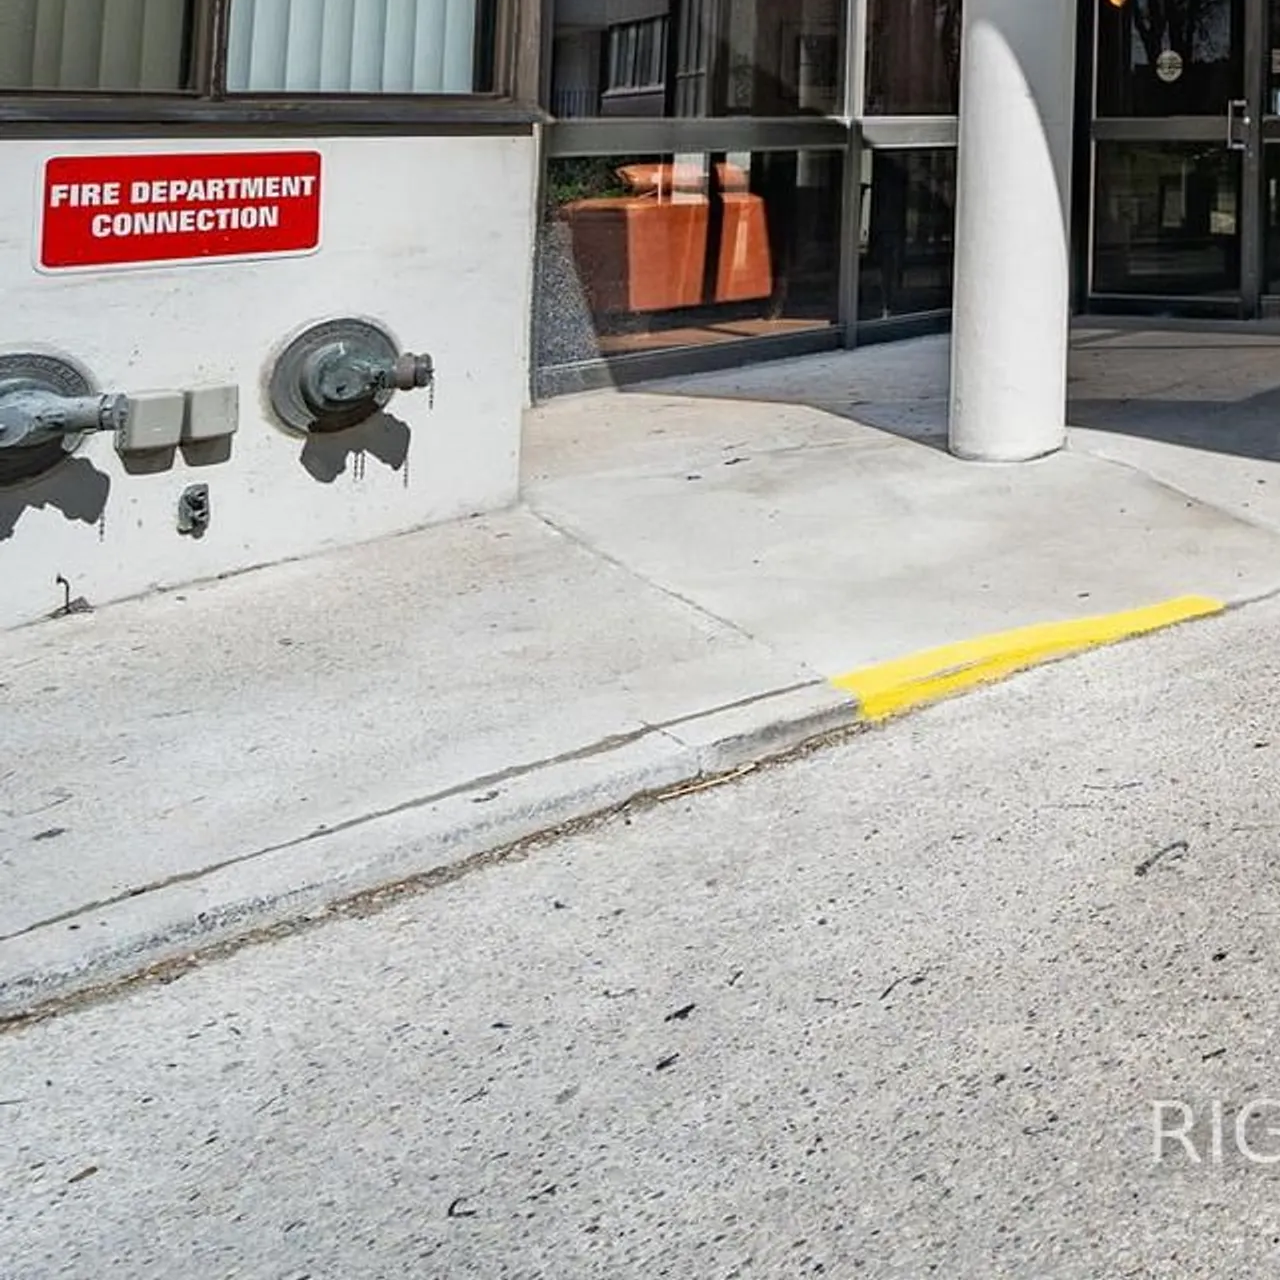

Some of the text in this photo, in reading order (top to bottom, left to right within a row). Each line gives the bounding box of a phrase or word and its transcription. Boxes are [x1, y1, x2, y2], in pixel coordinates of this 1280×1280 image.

[51, 175, 316, 207] FIRE DEPARTMENT
[91, 206, 278, 237] CONNECTION
